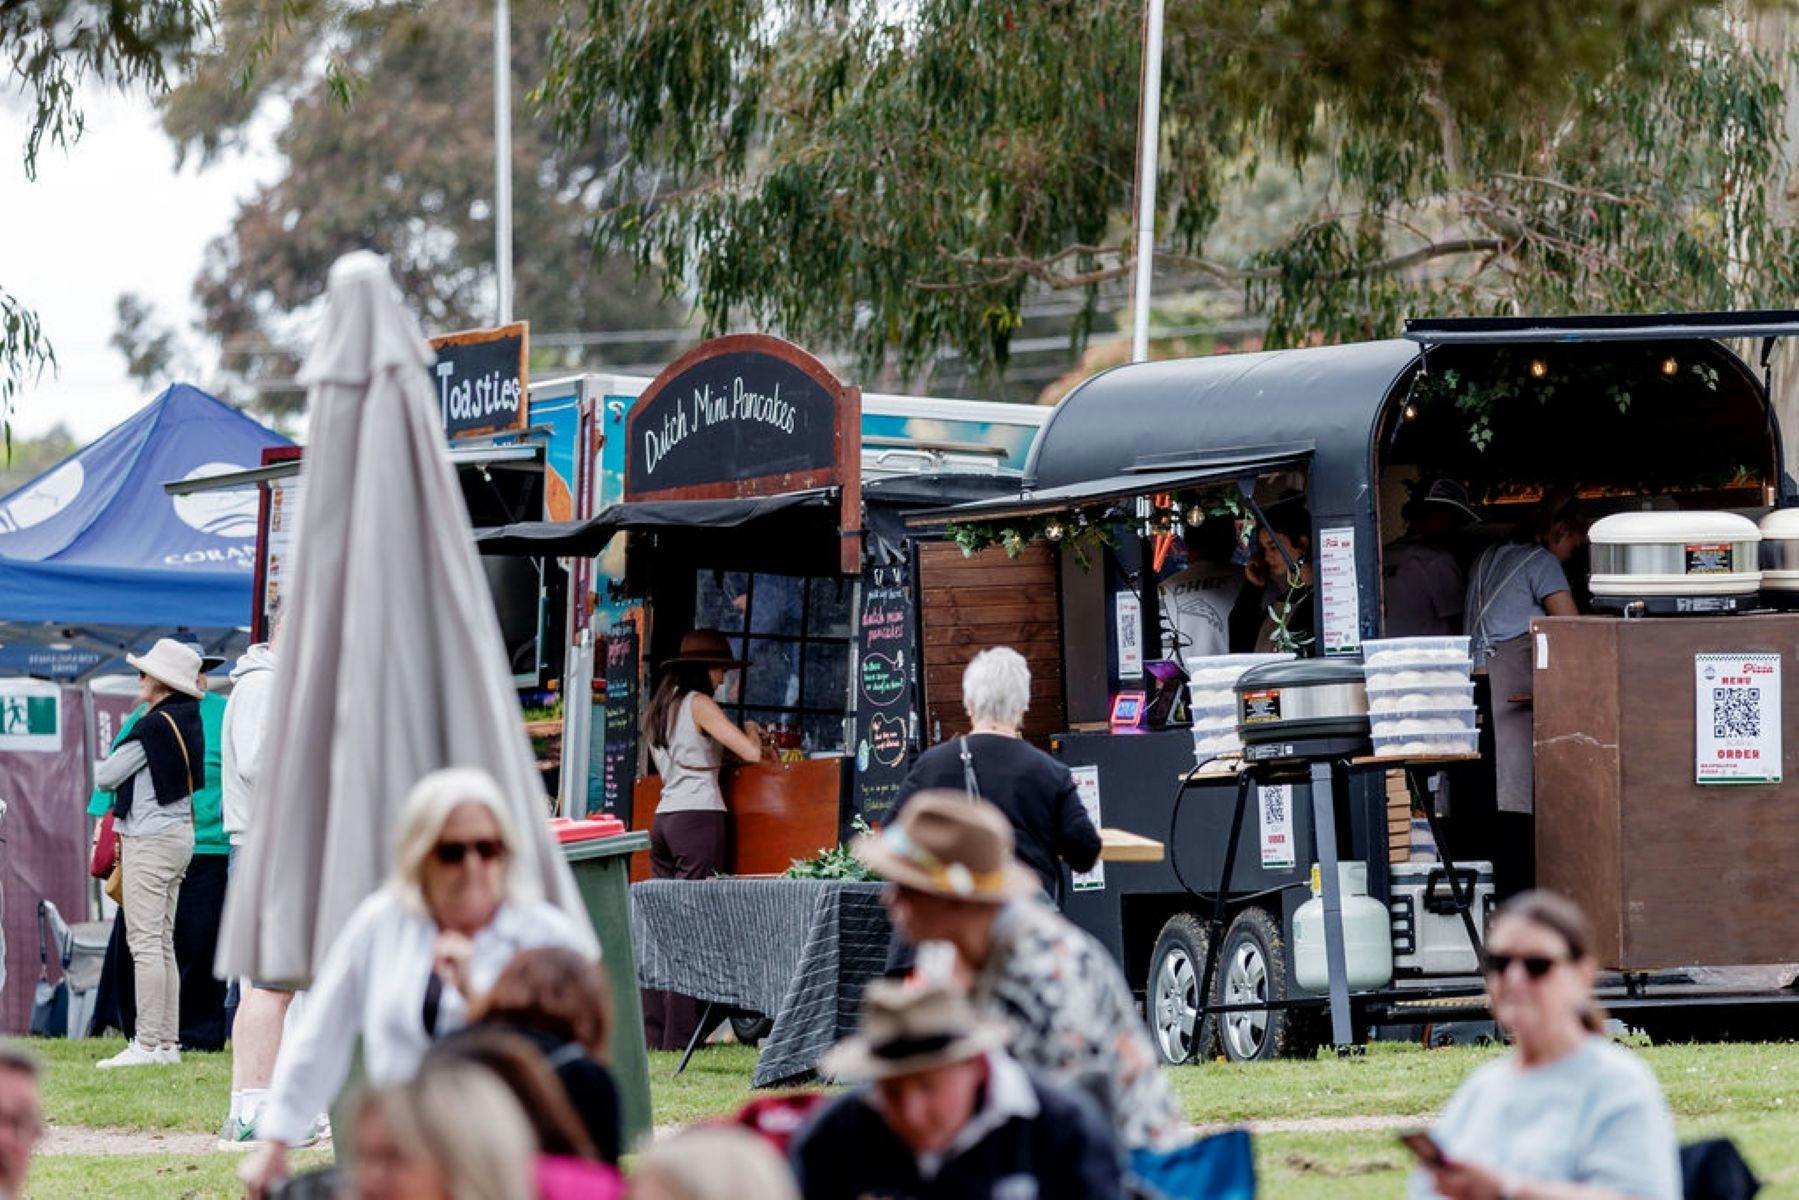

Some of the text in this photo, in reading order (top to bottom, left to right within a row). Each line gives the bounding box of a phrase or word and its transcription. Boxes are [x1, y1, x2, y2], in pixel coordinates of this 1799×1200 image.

[437, 361, 521, 429] Toasties
[645, 376, 796, 474] Dutch Mini Pancakes
[1721, 677, 1752, 685] MENU
[1717, 749, 1760, 759] ORDER
